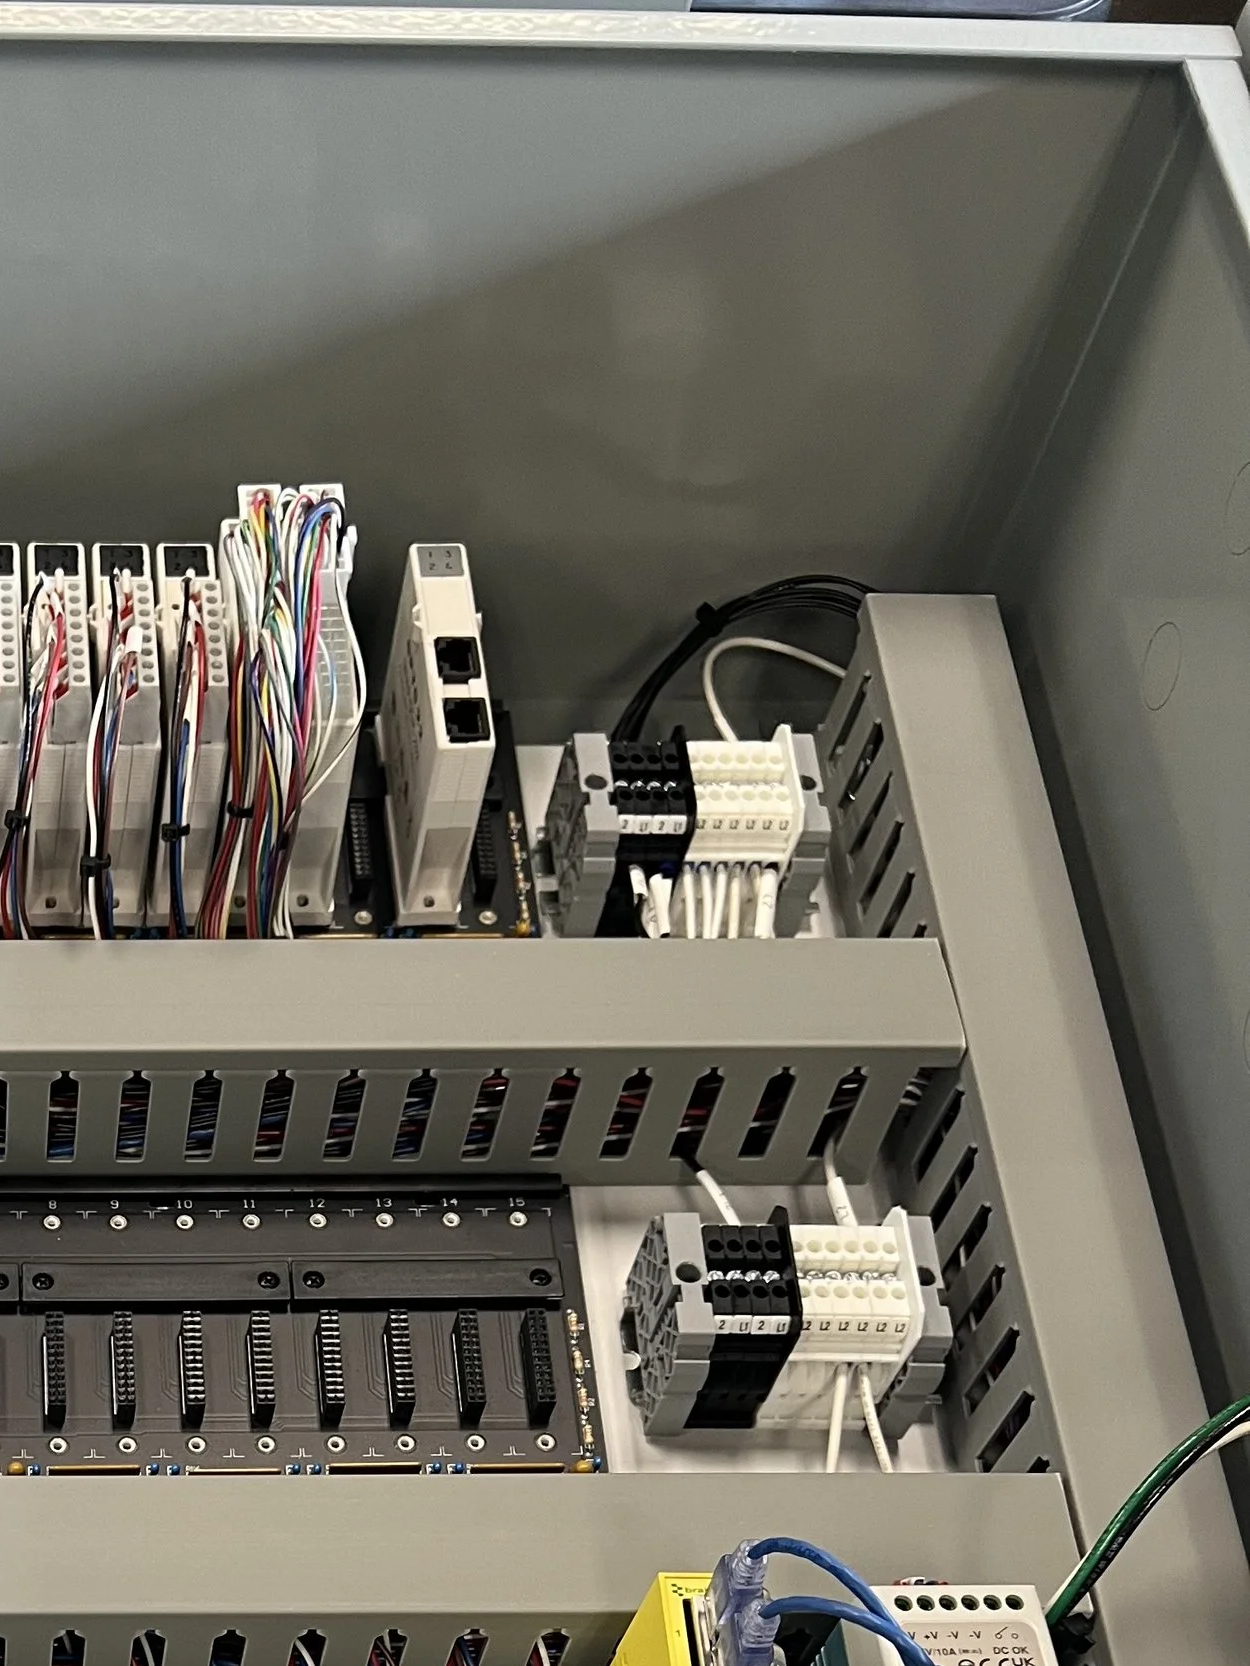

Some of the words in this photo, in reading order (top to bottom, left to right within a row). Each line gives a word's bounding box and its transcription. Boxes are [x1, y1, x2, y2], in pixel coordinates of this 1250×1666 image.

[718, 1320, 726, 1329] 2
[757, 1320, 765, 1330] 2
[820, 1321, 831, 1330] L2
[839, 1321, 850, 1331] L2
[857, 1322, 869, 1331] L2
[876, 1322, 887, 1332] L2
[895, 1323, 906, 1333] L2
[676, 1629, 681, 1637] 1
[924, 1631, 938, 1640] +V
[947, 1631, 959, 1639] -V
[969, 1630, 981, 1639] -V
[993, 1646, 1009, 1654] DC
[1012, 1646, 1030, 1654] OK
[1011, 1657, 1036, 1666] UK
